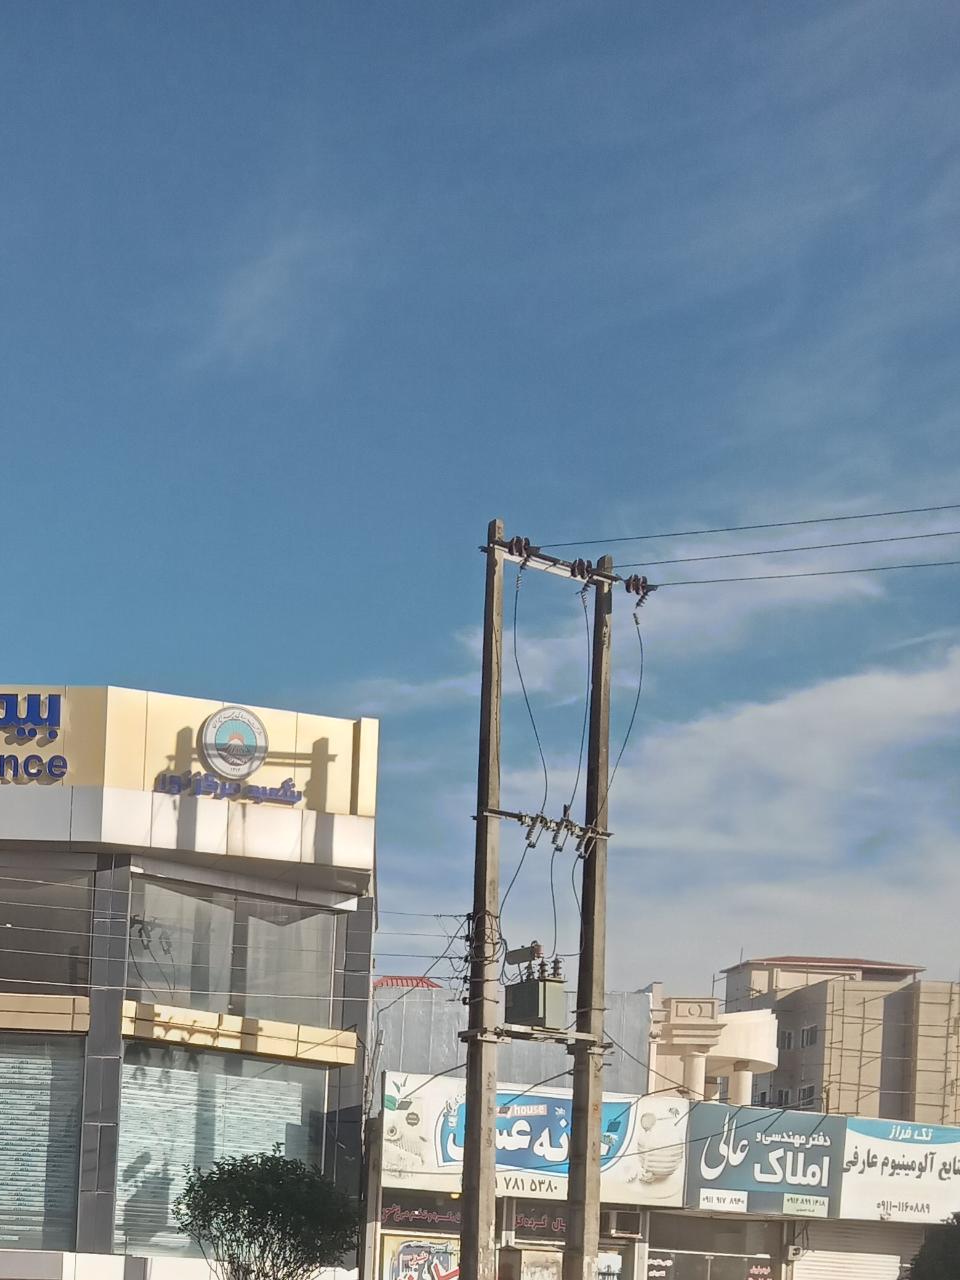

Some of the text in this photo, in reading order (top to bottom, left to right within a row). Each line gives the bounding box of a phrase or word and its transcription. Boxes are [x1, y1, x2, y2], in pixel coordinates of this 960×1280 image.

[513, 1104, 545, 1116] house
[762, 1130, 806, 1149] مهندسی
[805, 1131, 831, 1148] دفتر
[913, 1127, 933, 1141] تک
[700, 1111, 750, 1180] عالی
[753, 1148, 831, 1188] املاک
[842, 1146, 960, 1181] نایع آلومینیوم عارفی
[503, 1176, 525, 1191] ۷۸۱
[529, 1178, 558, 1193] ۵۳۸۰
